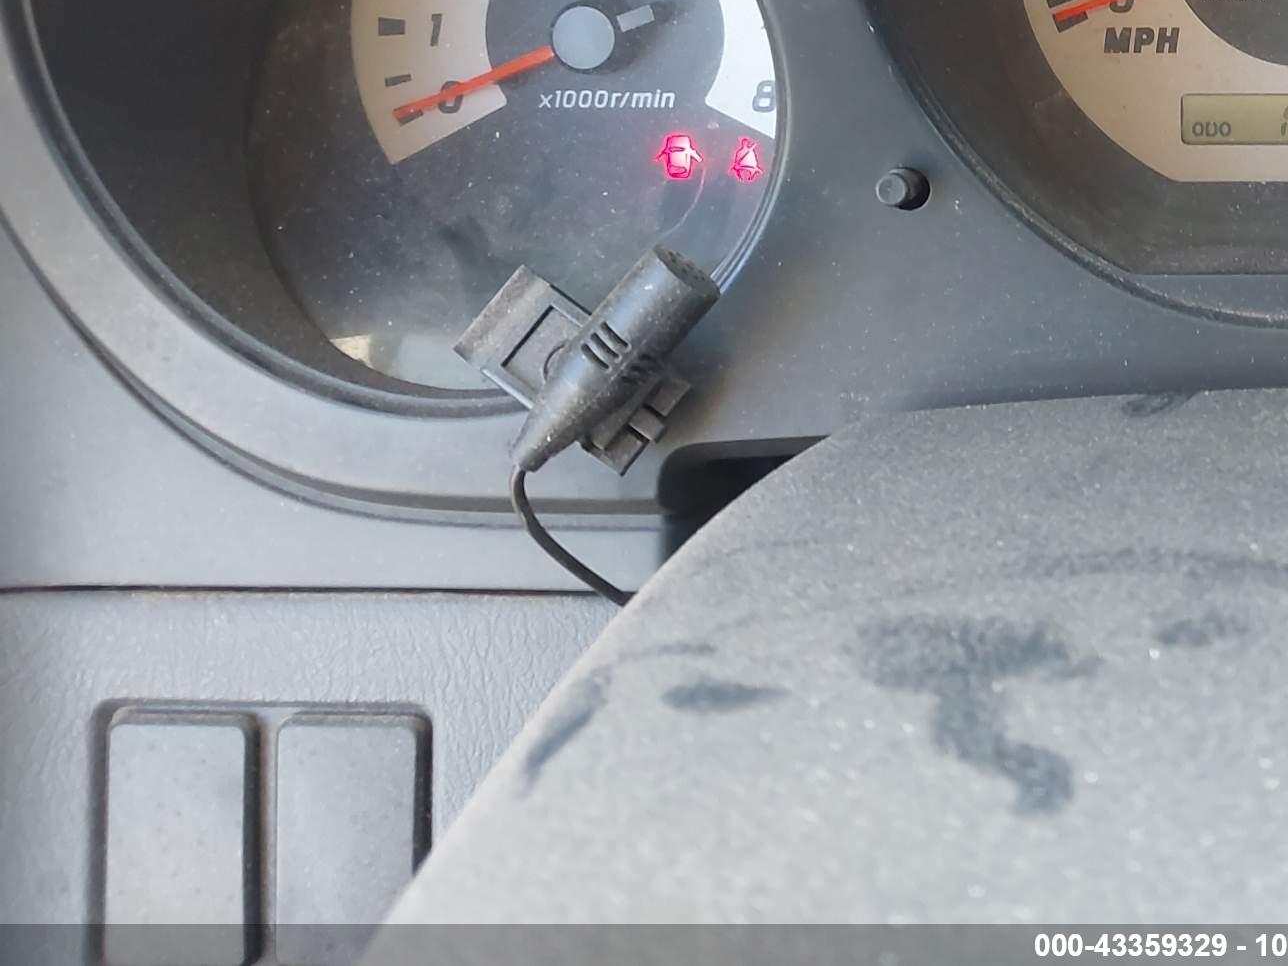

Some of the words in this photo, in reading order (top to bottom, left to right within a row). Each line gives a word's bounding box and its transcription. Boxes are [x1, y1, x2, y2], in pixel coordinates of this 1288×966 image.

[430, 14, 444, 47] 1
[1103, 27, 1180, 54] MPH
[437, 81, 464, 114] 0
[538, 89, 676, 110] x1000r/min
[752, 80, 777, 113] 8
[1191, 121, 1232, 138] ODO
